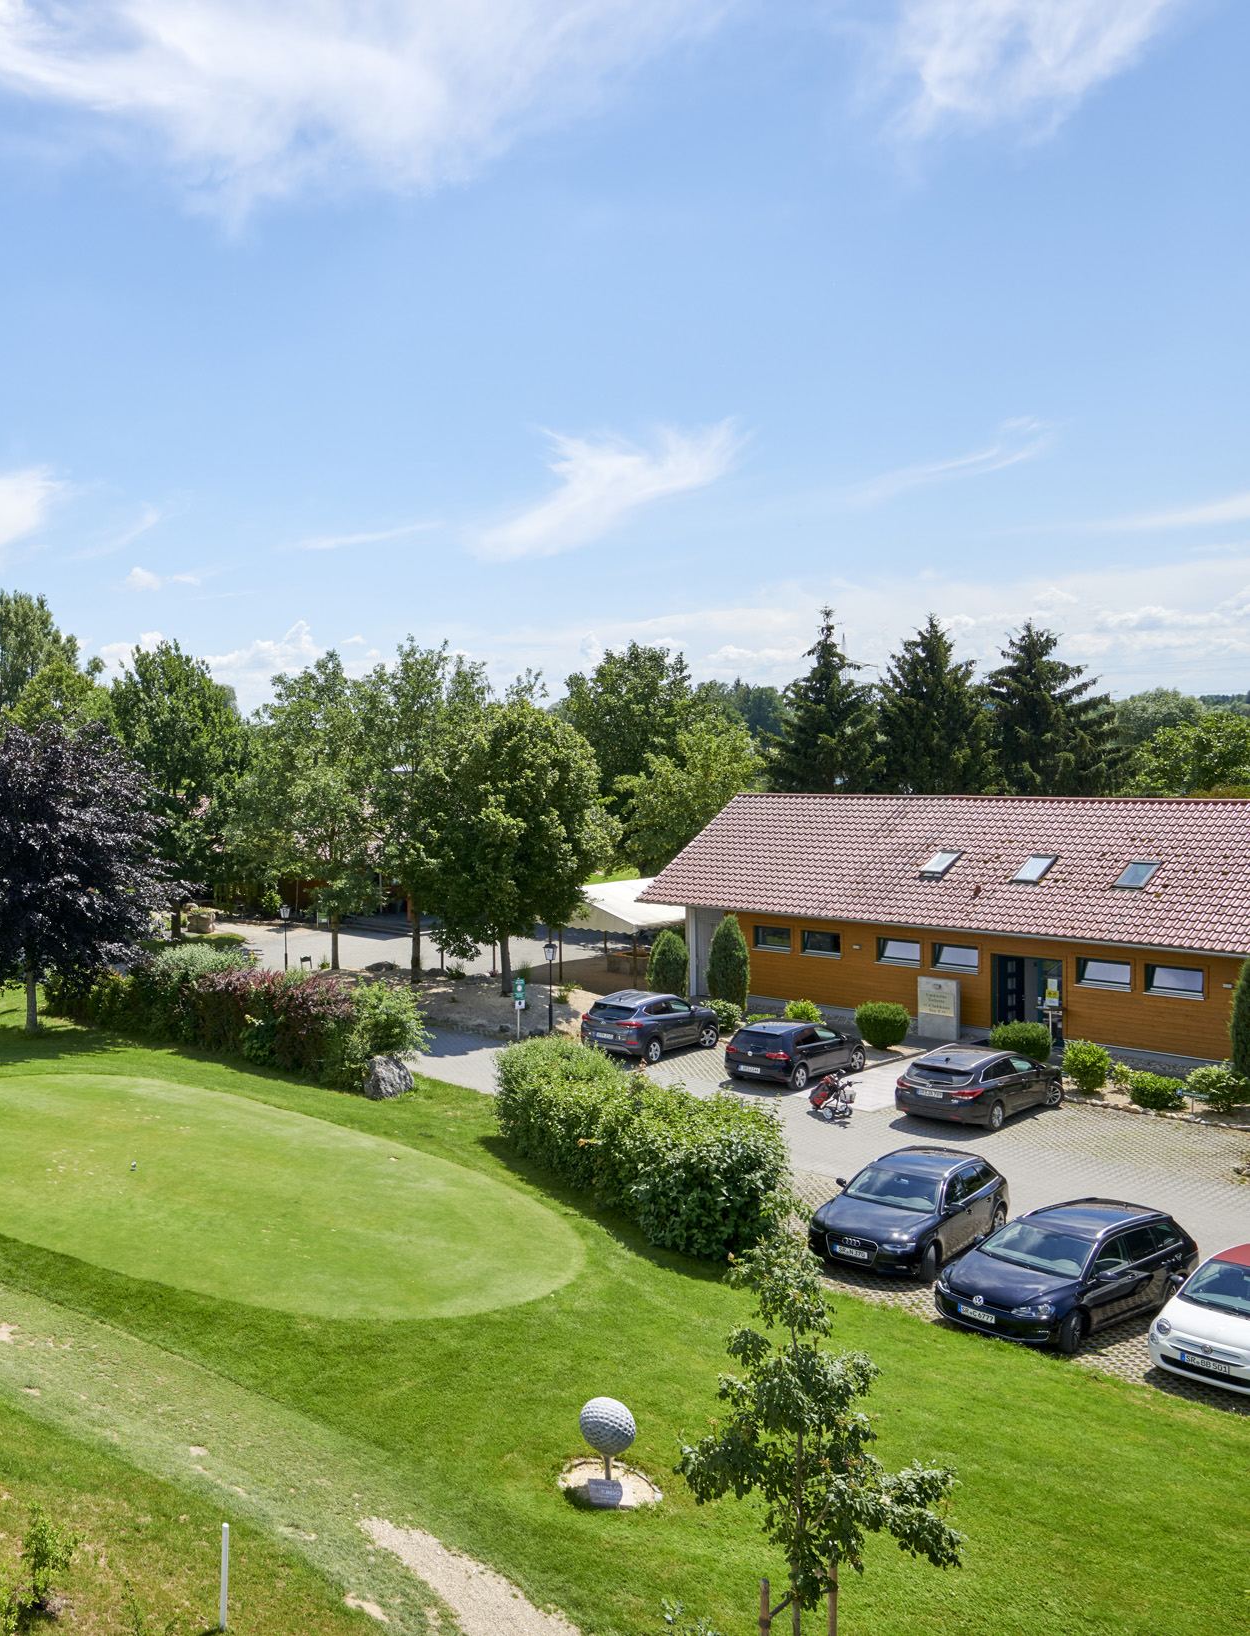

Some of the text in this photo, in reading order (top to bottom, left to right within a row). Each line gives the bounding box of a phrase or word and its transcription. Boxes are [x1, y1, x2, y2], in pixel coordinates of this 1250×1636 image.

[978, 1312, 994, 1322] 6777
[1185, 1355, 1228, 1373] SR BB 501
